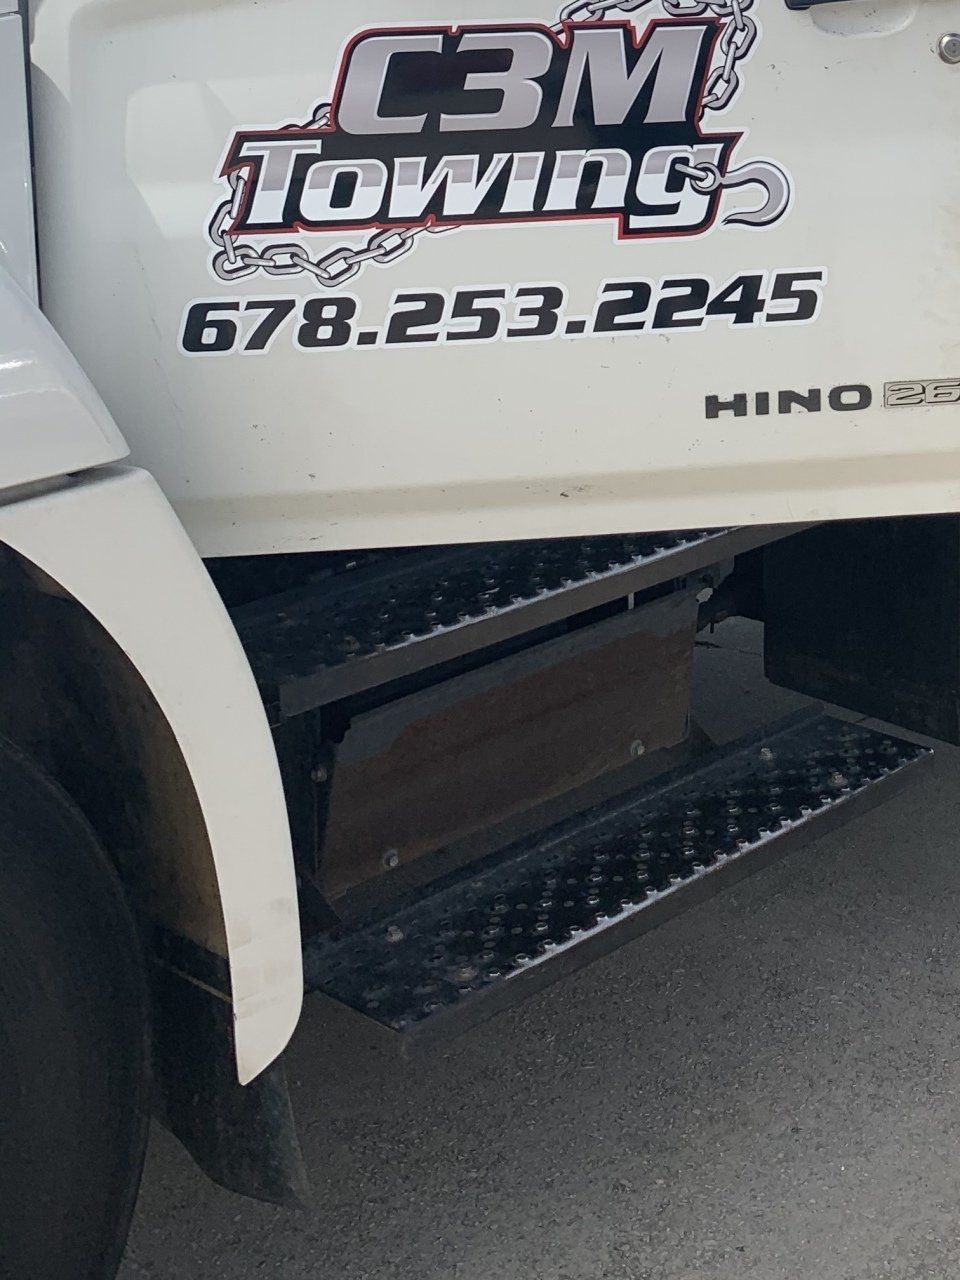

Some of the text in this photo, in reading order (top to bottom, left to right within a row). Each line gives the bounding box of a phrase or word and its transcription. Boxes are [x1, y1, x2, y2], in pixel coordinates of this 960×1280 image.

[337, 23, 709, 135] C3M
[180, 270, 824, 354] 678.253.2245
[704, 384, 873, 419] HINO
